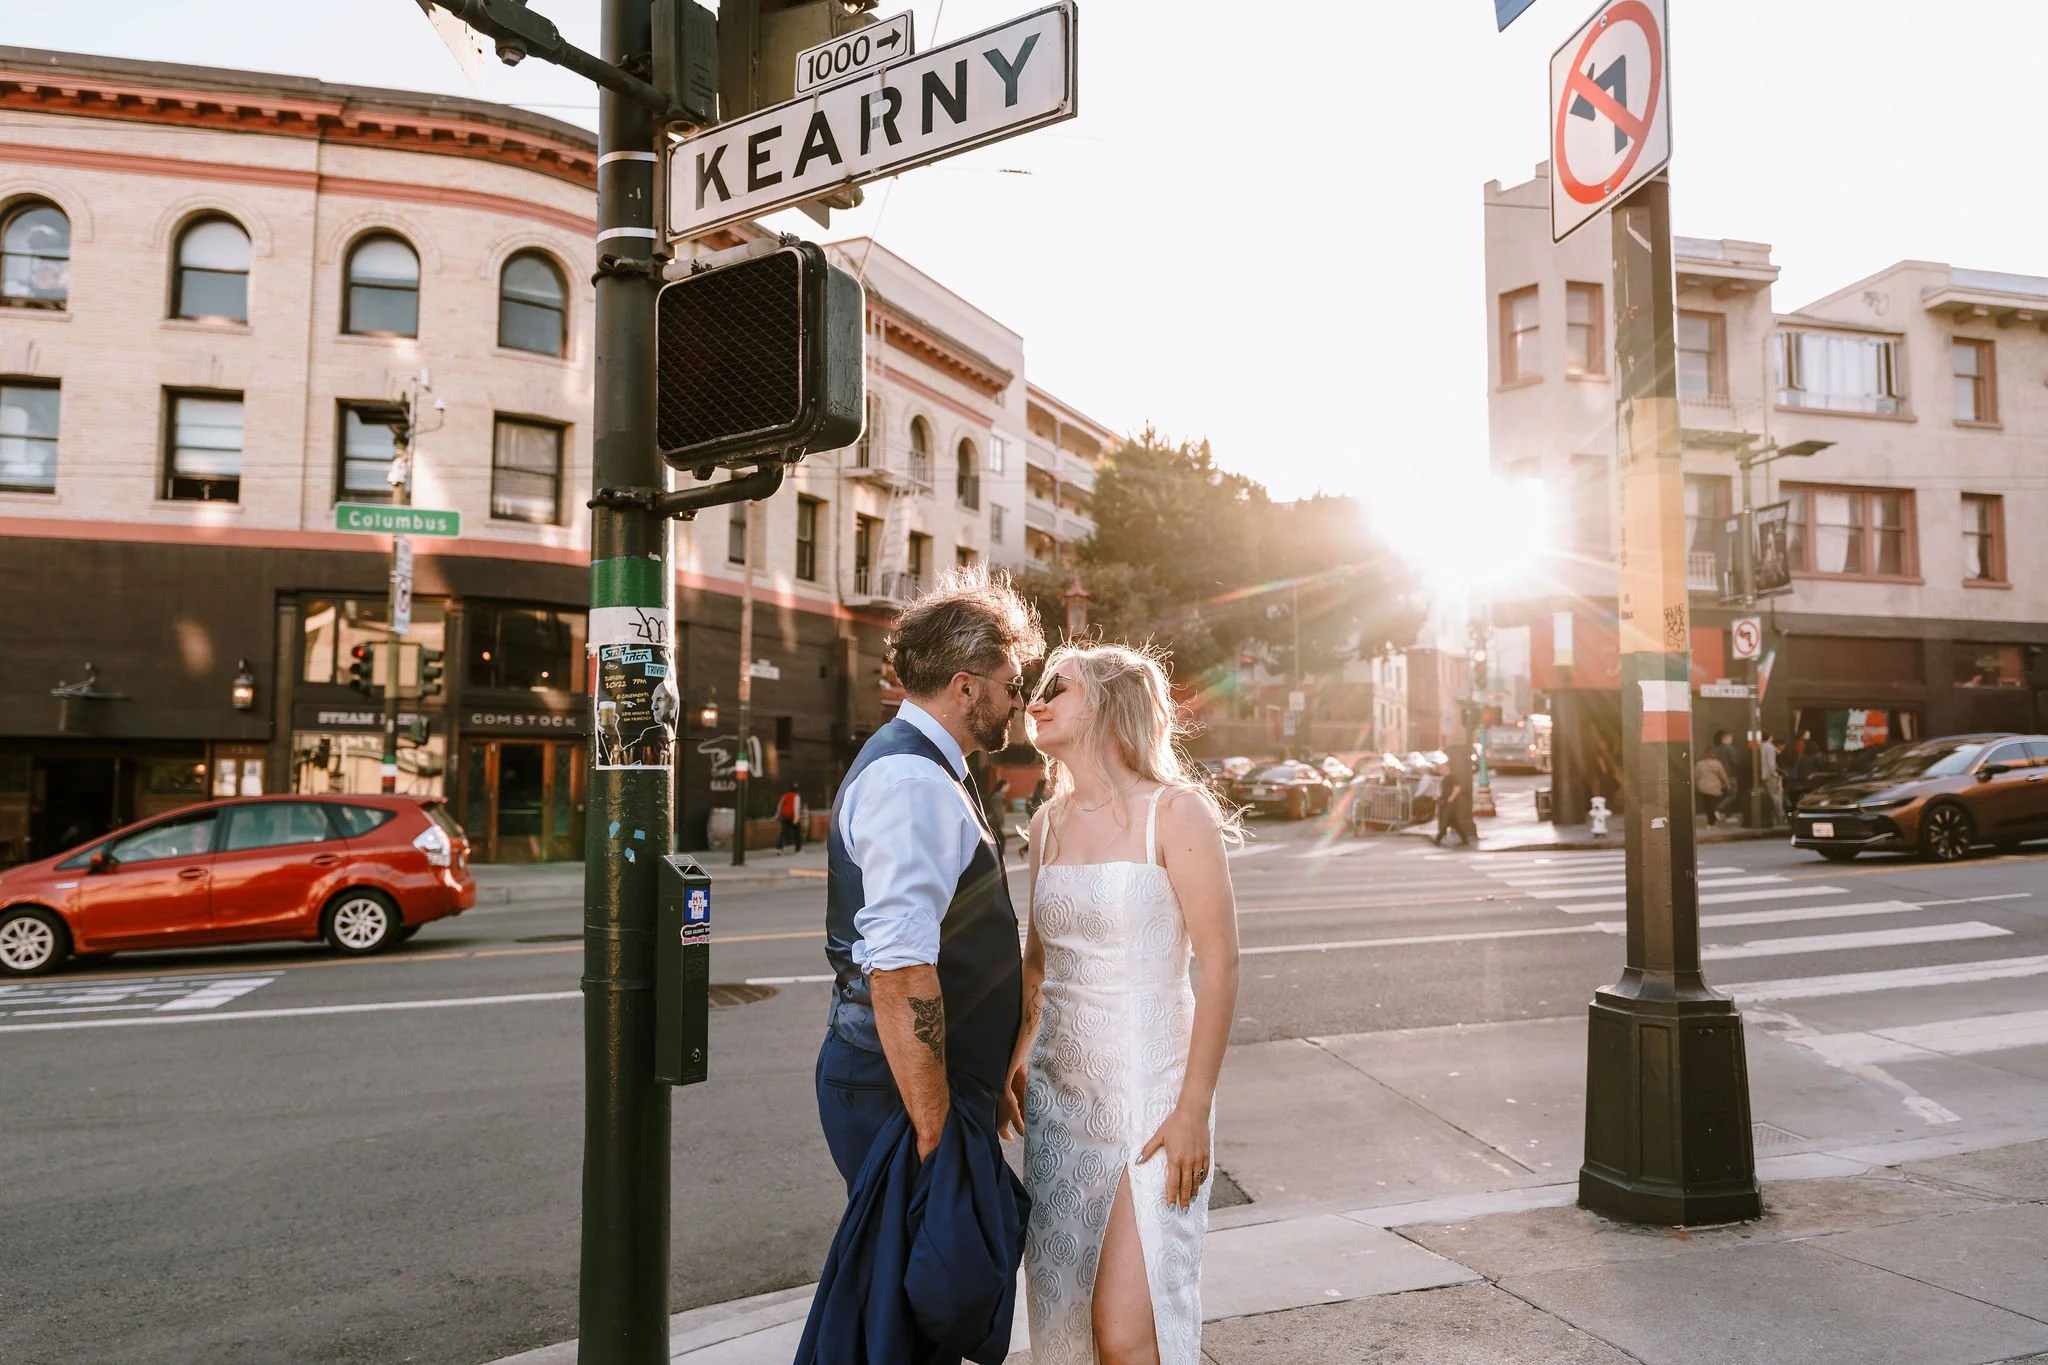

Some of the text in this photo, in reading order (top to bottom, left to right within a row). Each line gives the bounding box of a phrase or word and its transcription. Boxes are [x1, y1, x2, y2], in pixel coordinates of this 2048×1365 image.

[807, 35, 870, 83] 1000
[695, 32, 1041, 211] KEARNY
[348, 510, 448, 532] Columbus
[318, 712, 375, 725] STEAM
[471, 712, 577, 728] COMSTOCK
